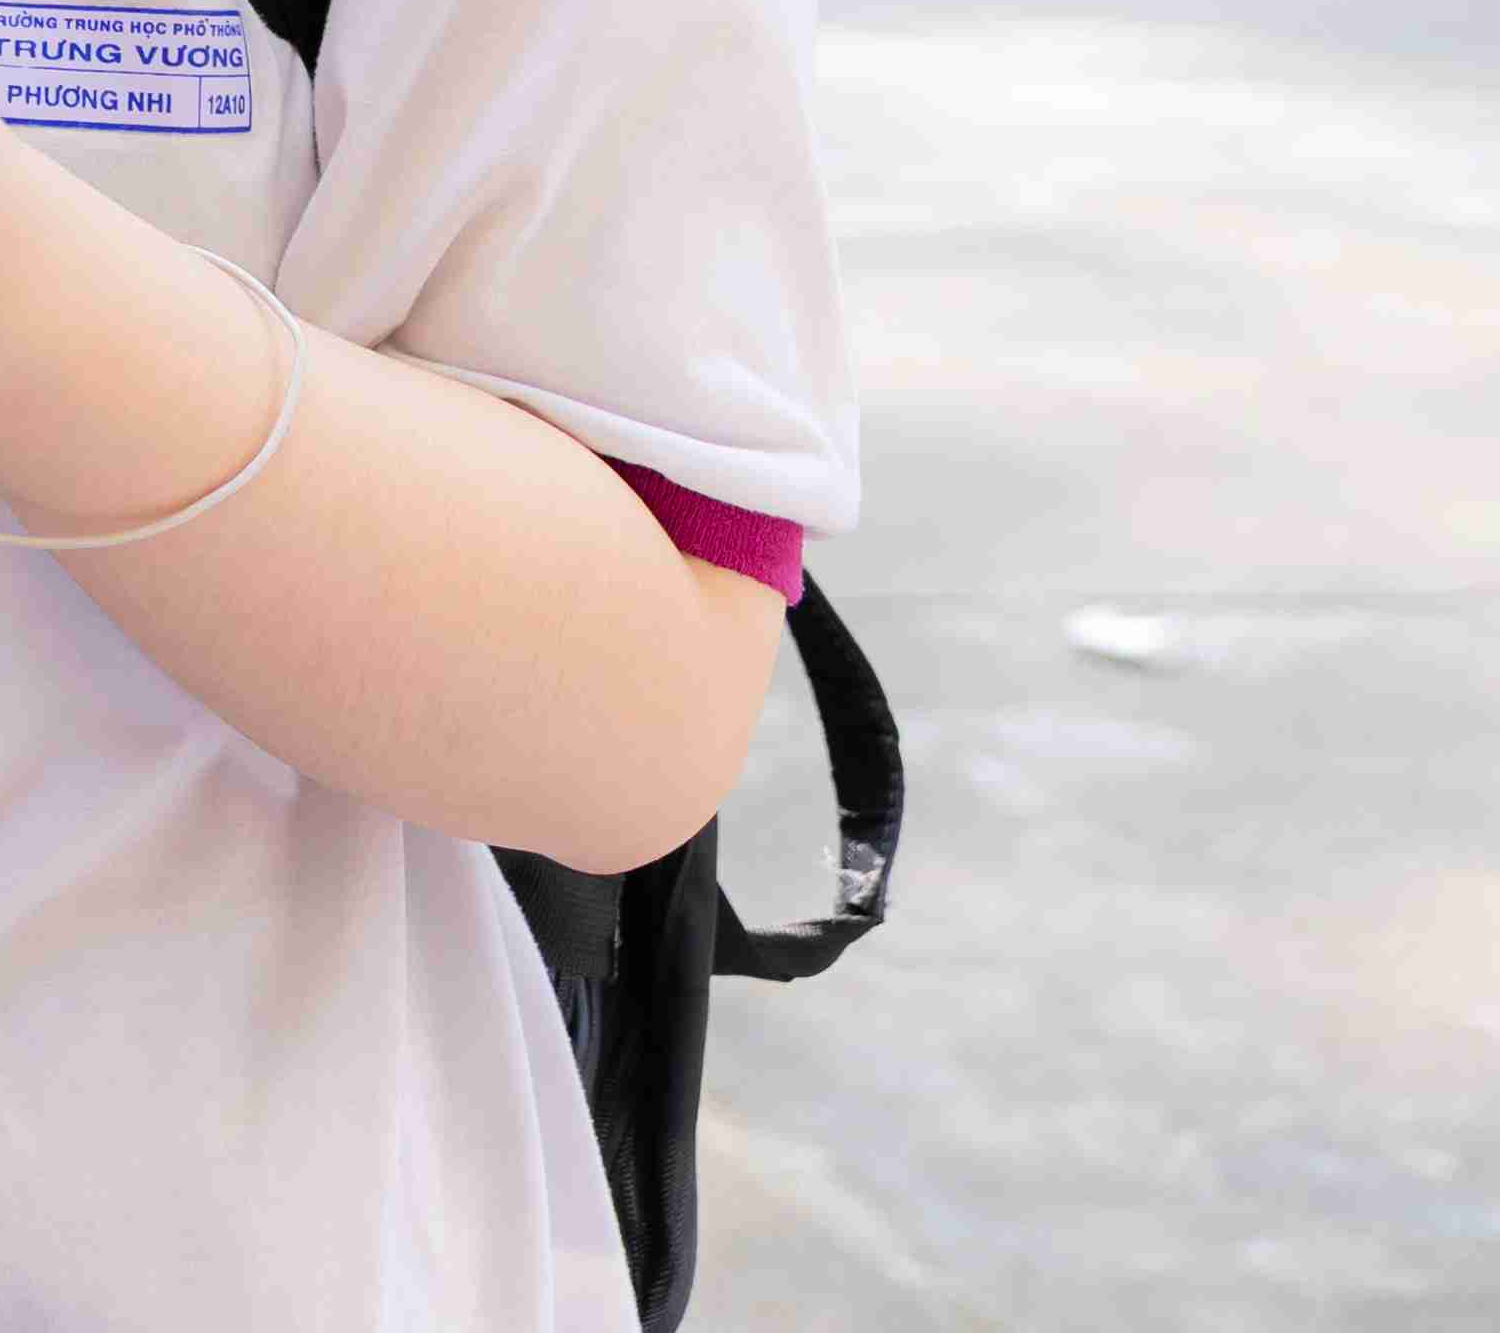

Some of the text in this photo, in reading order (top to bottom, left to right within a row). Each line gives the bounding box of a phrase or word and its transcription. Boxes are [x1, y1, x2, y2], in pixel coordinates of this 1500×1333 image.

[65, 17, 123, 33] TRUNG
[130, 21, 166, 39] HỌC
[135, 44, 244, 68] VƯƠNG
[7, 84, 245, 115] PHƯƠNG NHI 12A10
